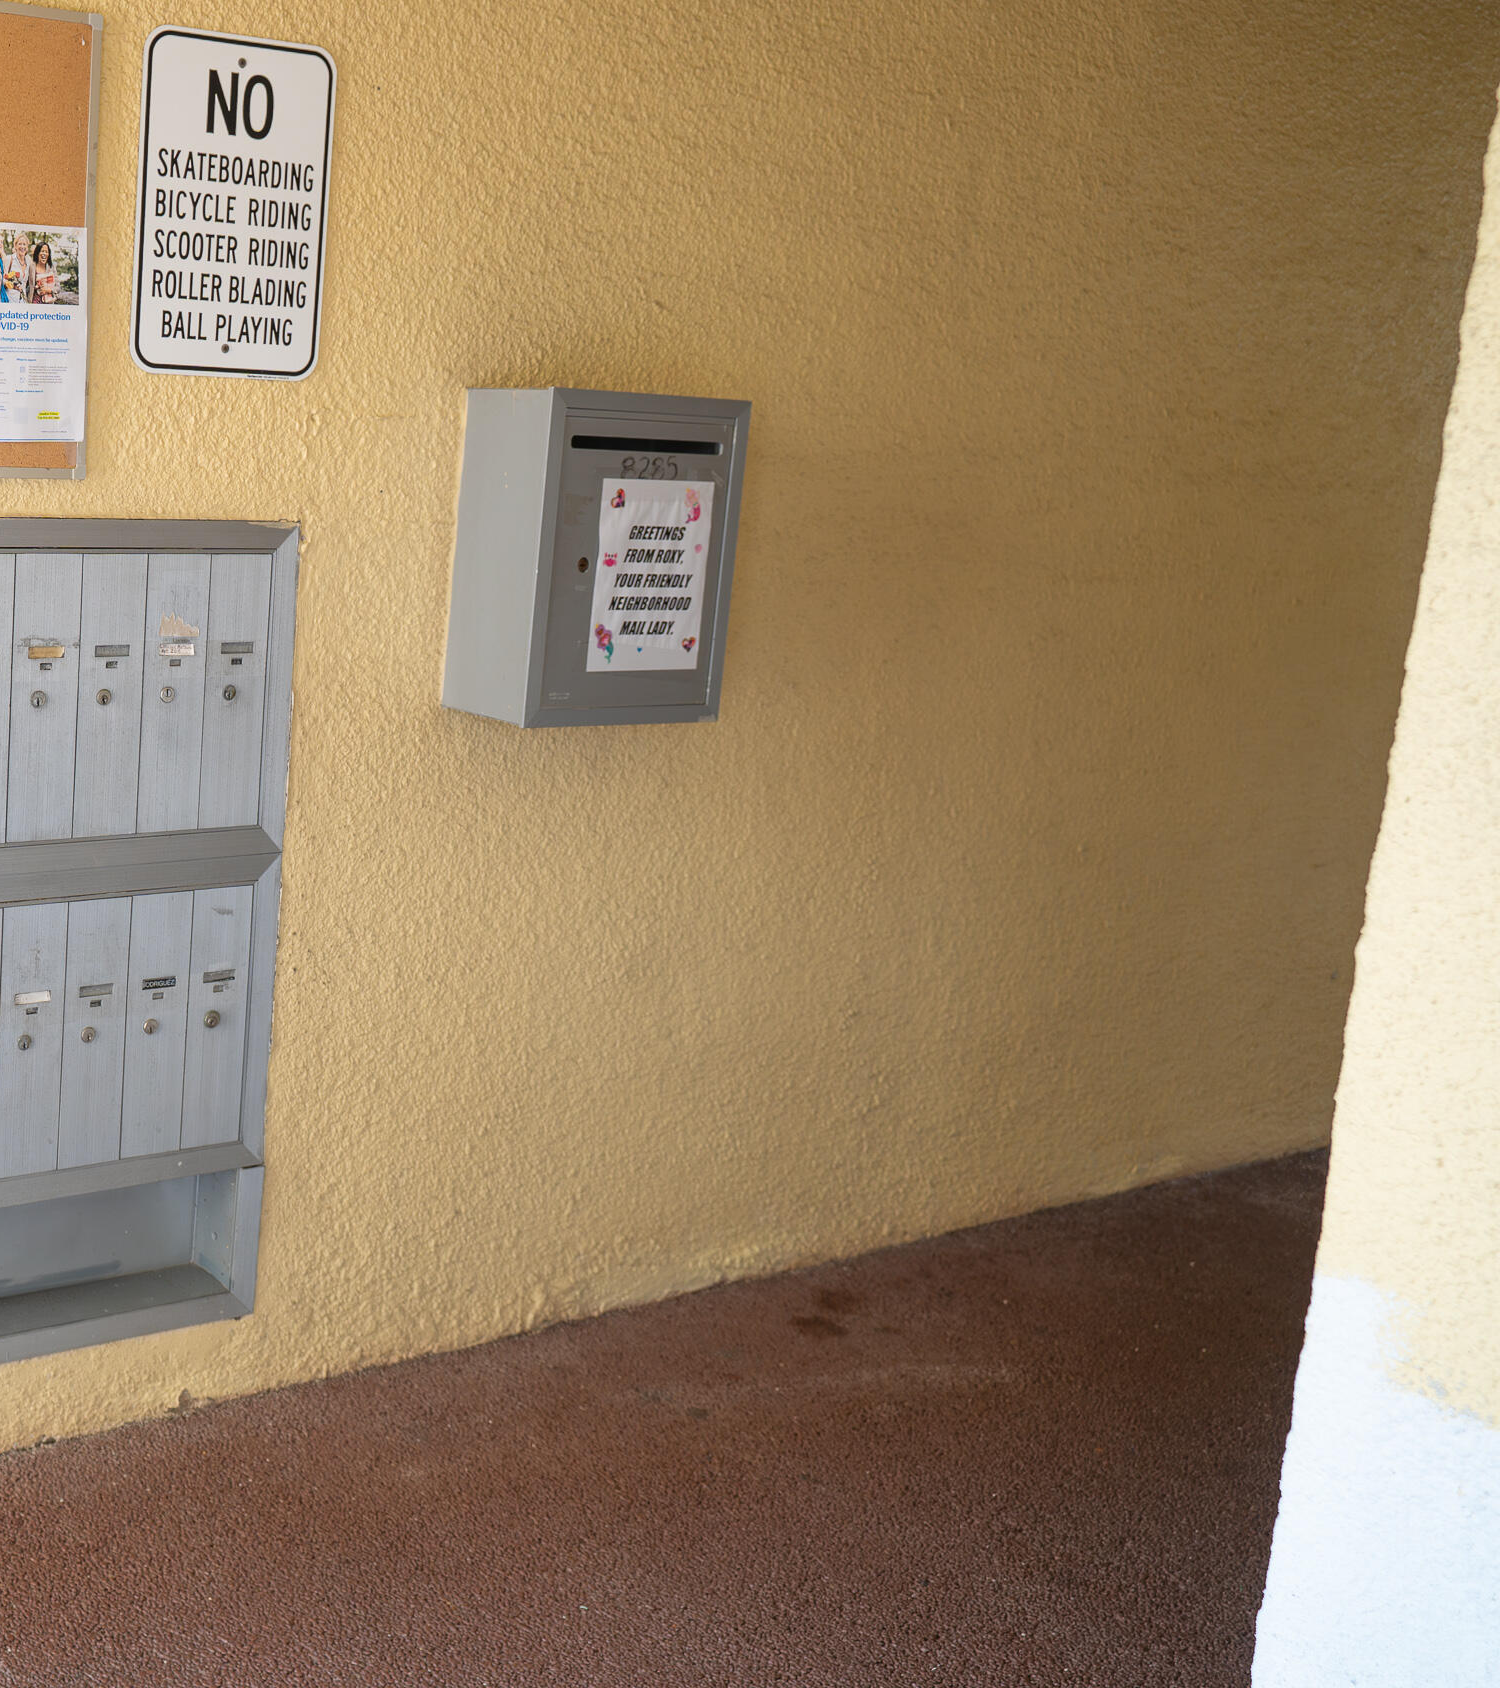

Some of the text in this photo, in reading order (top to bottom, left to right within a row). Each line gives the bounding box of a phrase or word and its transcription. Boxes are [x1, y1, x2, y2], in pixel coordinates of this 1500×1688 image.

[206, 69, 274, 139] NO
[157, 148, 314, 192] SKATEBOARDING
[155, 189, 312, 231] BICYCLE RIDING
[153, 230, 309, 270] SCOOTER RIDING
[152, 270, 307, 308] ROLLER BLADING
[30, 311, 71, 321] protection
[161, 310, 293, 346] BALL PLAYING
[628, 525, 686, 541] GREETINGS
[623, 549, 685, 565] FROM ROXY,
[614, 573, 692, 588] YOUR FRIENDLY
[608, 596, 692, 611] NEIGHBORHOOD
[619, 620, 674, 635] MAIL LADY.
